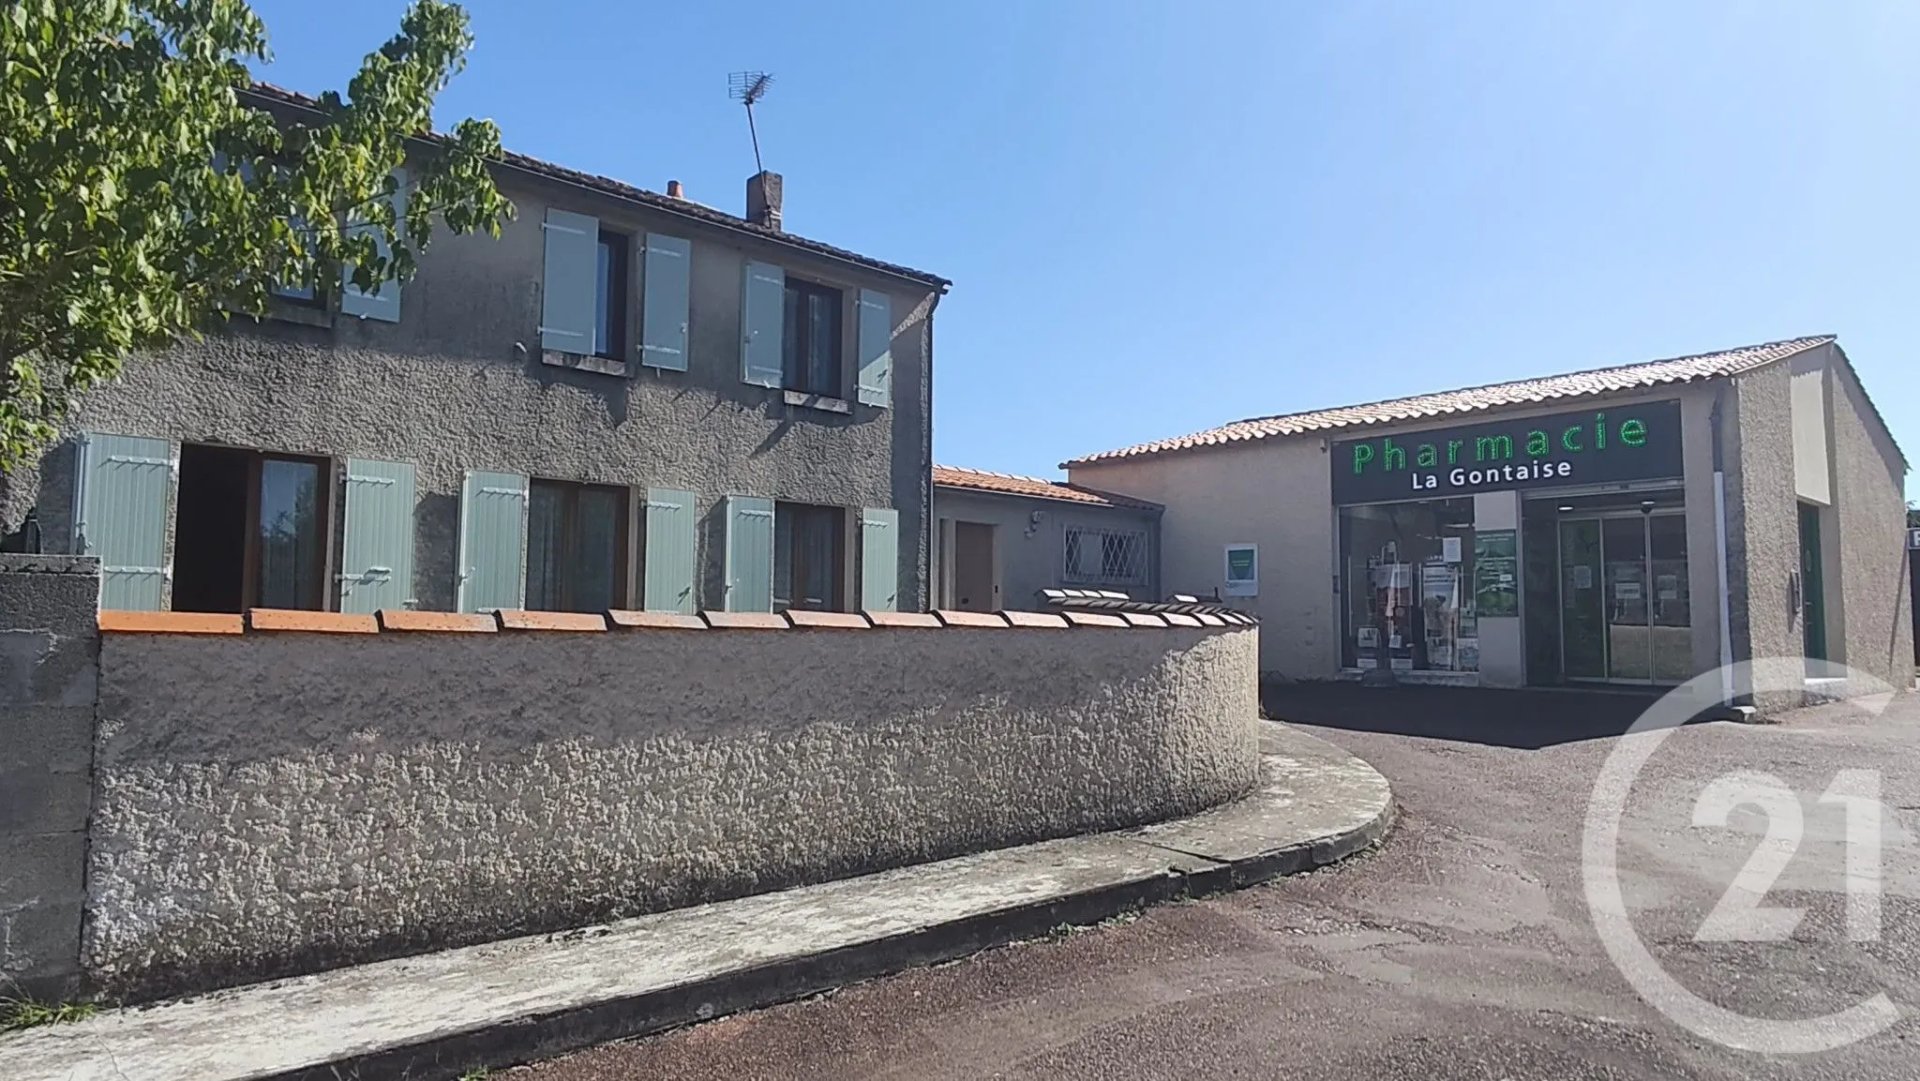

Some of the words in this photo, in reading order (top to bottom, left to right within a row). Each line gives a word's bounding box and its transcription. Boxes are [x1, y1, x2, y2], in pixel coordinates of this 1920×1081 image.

[1352, 412, 1648, 475] Pharmacie
[1412, 472, 1438, 490] La
[1450, 460, 1572, 486] Gontaise
